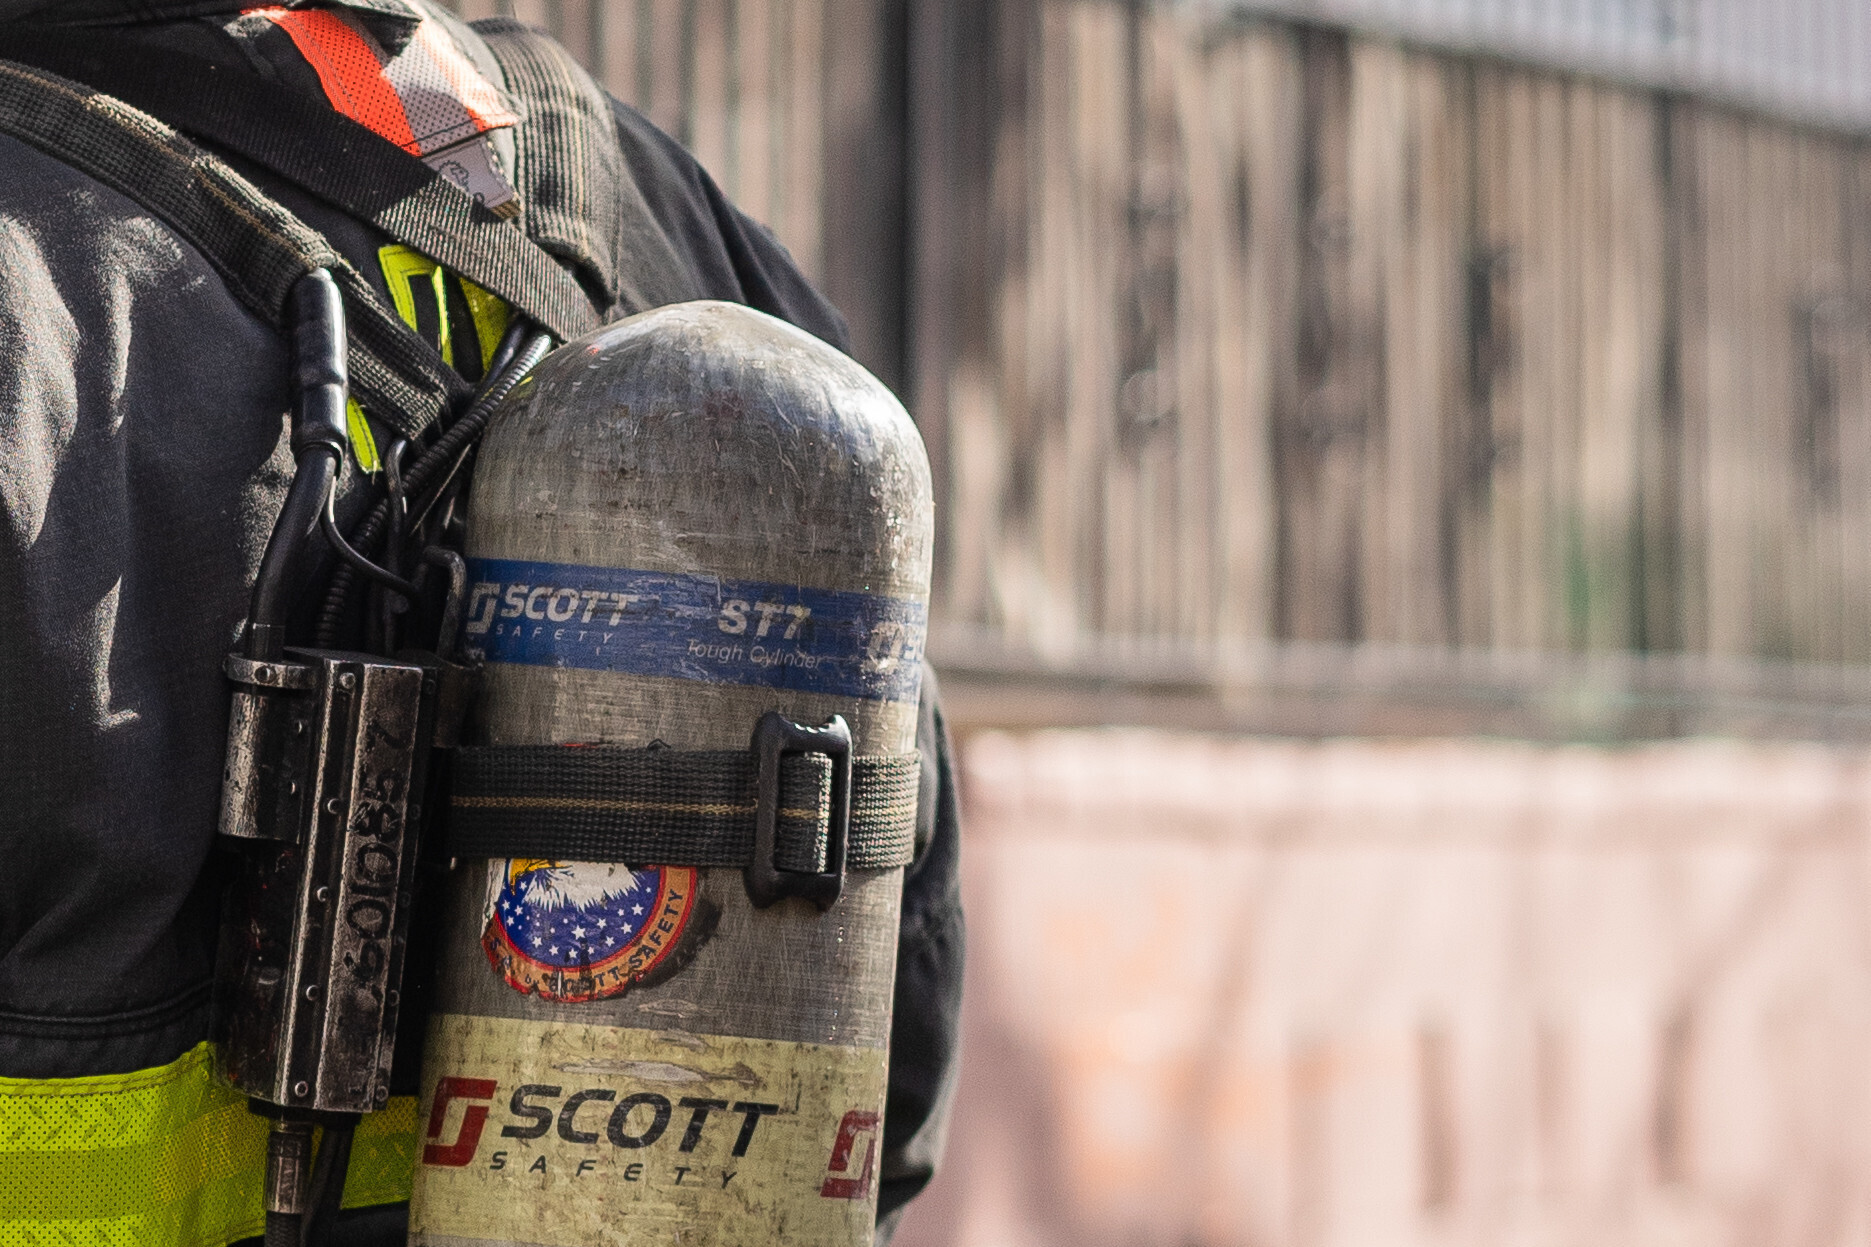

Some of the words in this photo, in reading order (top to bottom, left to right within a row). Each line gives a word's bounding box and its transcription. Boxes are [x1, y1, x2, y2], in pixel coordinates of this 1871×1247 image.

[501, 584, 639, 627] SCOTT
[718, 599, 812, 640] ST7
[496, 623, 614, 645] SAFETY
[686, 638, 743, 663] Tough
[749, 644, 822, 669] Cylinder
[628, 888, 684, 970] SAFETY
[501, 1083, 780, 1158] SCOTT
[489, 1152, 736, 1189] SAFETY
